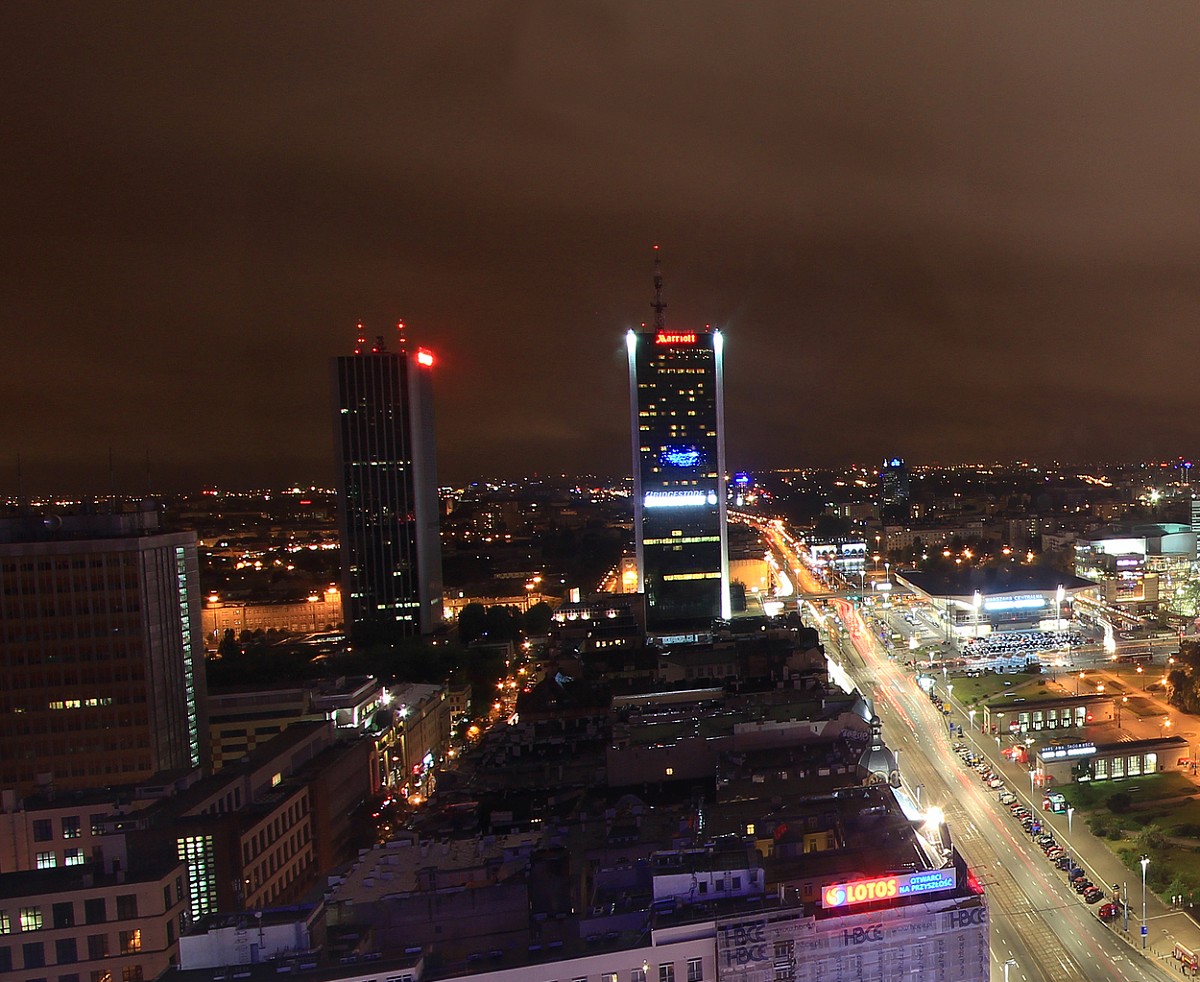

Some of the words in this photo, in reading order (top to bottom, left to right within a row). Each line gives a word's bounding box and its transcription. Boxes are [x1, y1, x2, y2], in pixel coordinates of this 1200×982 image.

[656, 334, 695, 344] Marriott
[910, 873, 942, 885] OTWARCI
[847, 879, 897, 902] LOTOS
[899, 885, 910, 893] NA
